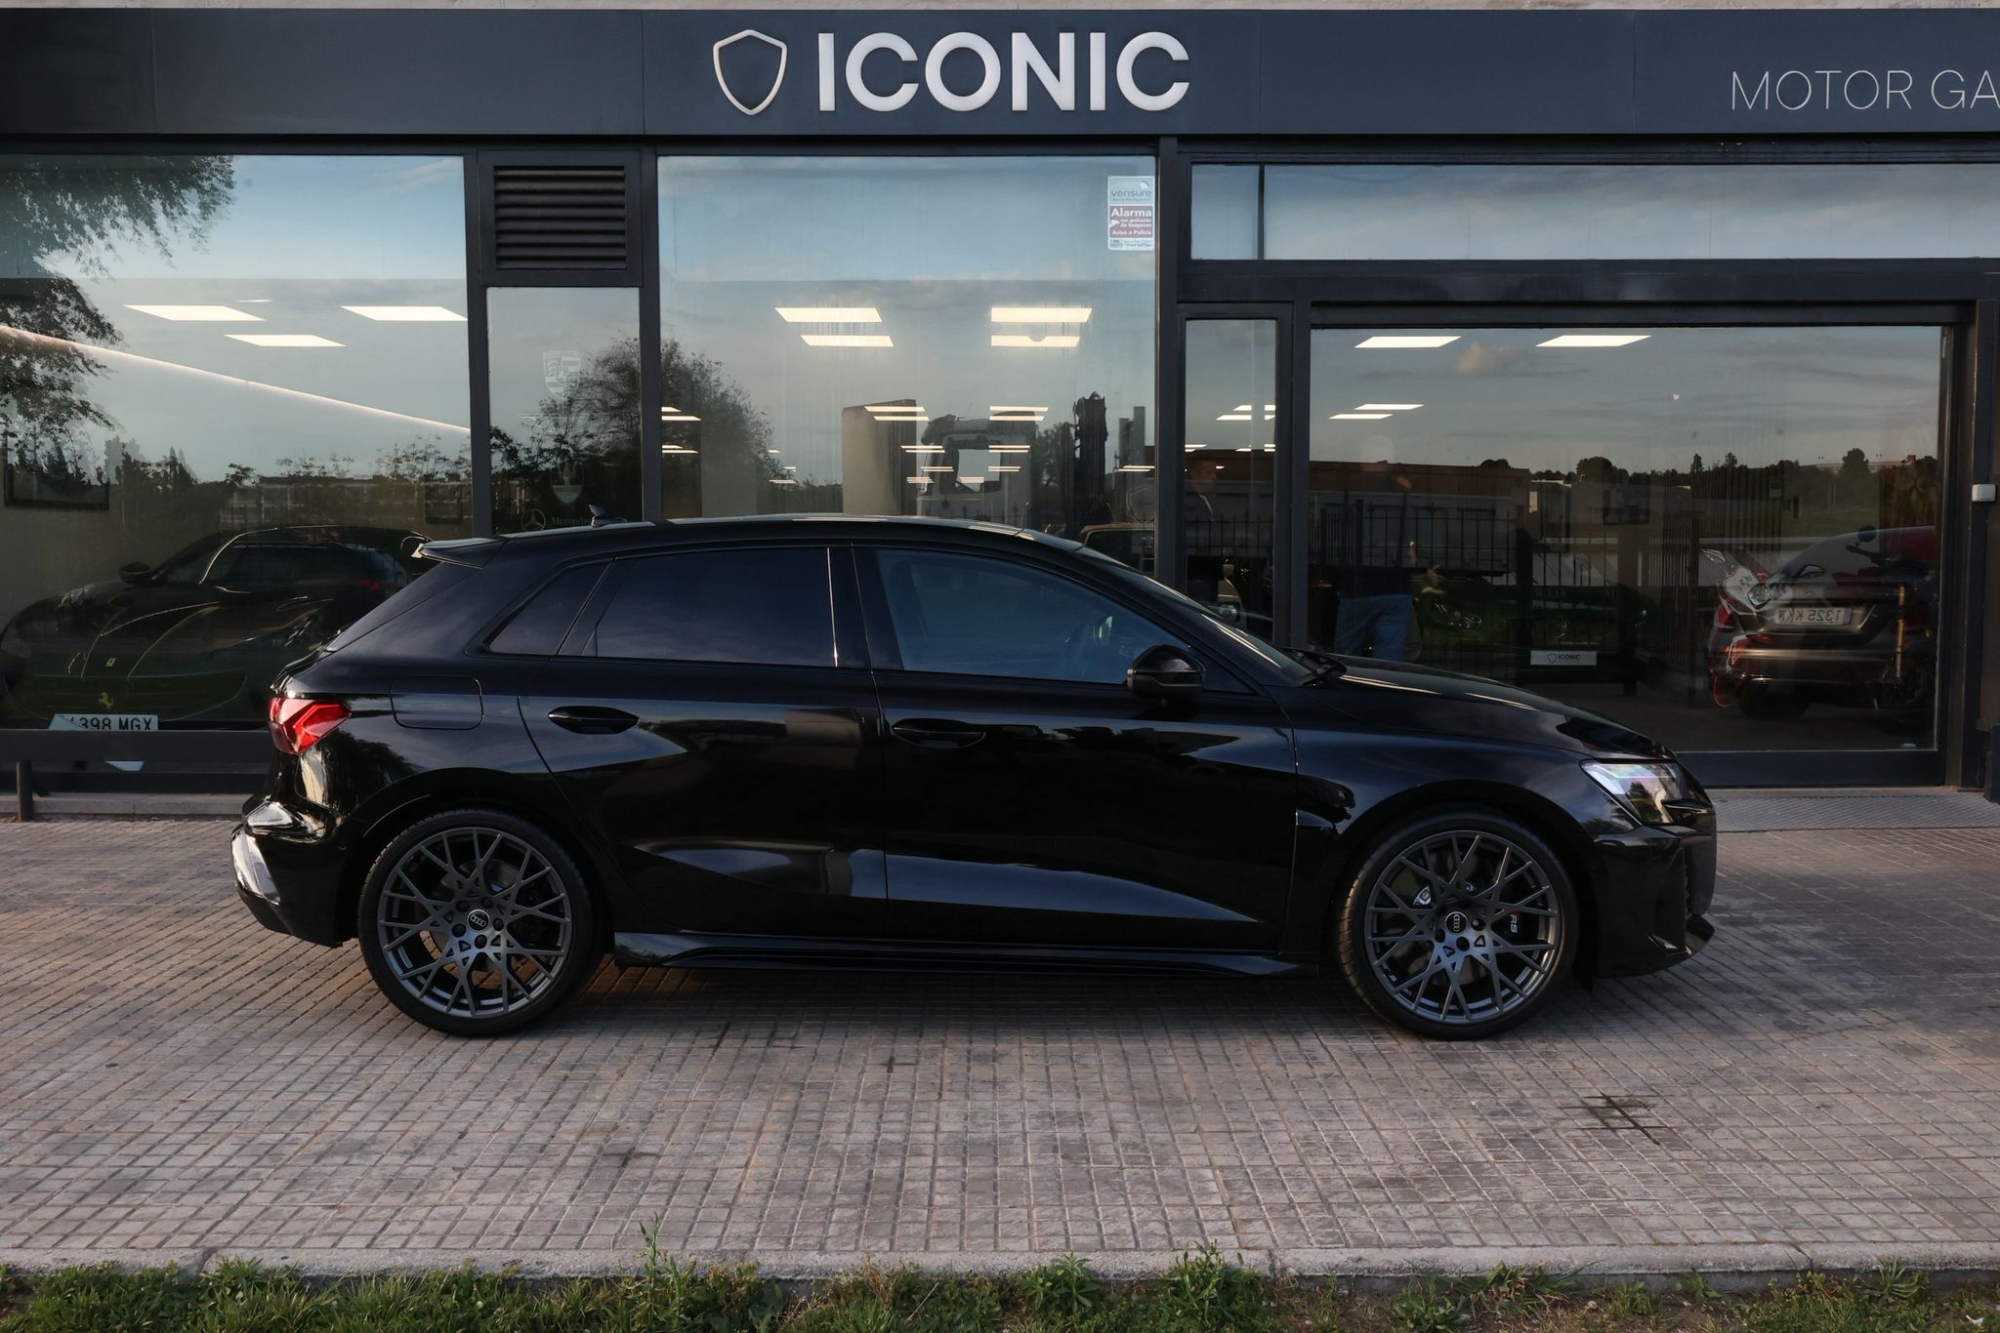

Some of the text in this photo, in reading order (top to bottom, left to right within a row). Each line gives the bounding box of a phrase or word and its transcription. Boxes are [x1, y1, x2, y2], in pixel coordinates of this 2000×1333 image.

[817, 31, 1190, 112] ICONIC
[1731, 69, 1913, 110] MOTOR
[1111, 207, 1152, 217] Alarma
[70, 716, 152, 731] 398 MGX
